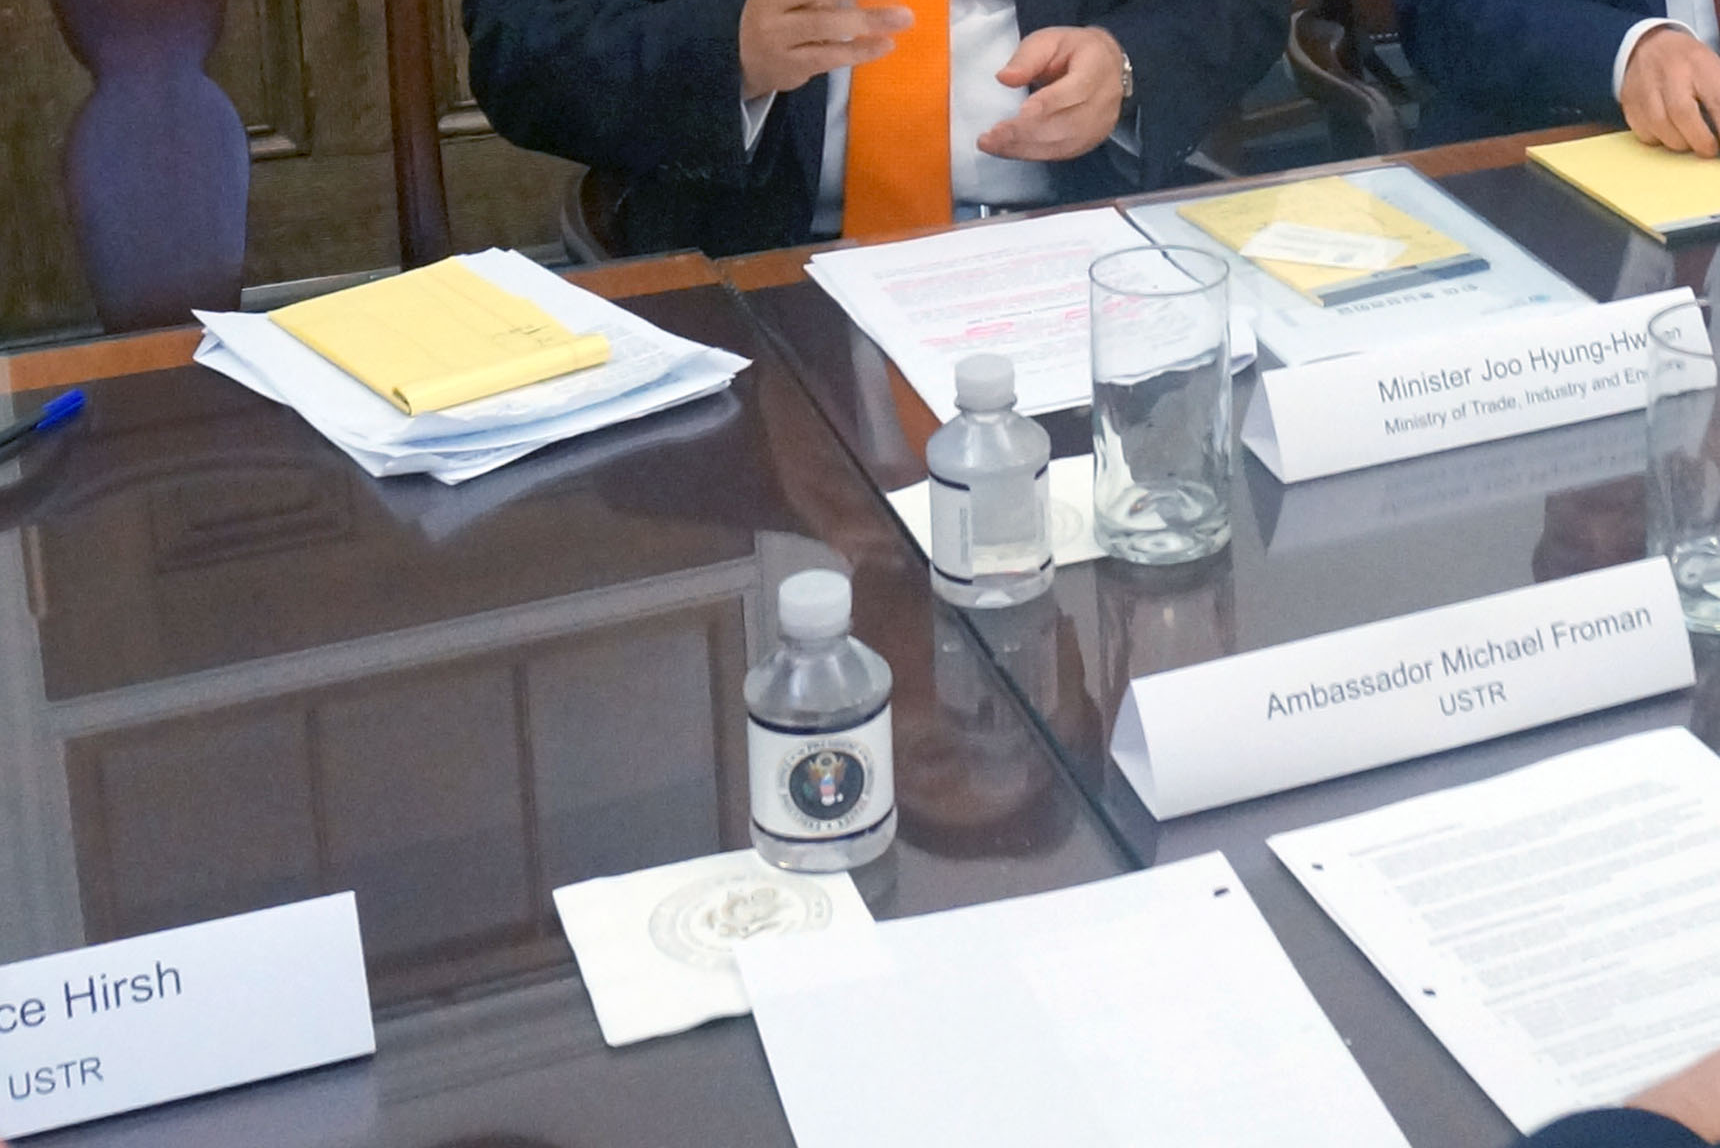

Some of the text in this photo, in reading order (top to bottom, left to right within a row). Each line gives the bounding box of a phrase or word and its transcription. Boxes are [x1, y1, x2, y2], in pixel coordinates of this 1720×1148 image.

[1377, 367, 1472, 403] Minister
[1481, 358, 1523, 382] Joo
[1384, 412, 1448, 436] Ministry
[1452, 403, 1467, 422] of
[1525, 382, 1587, 405] Industry
[1592, 372, 1620, 392] and
[1267, 606, 1652, 720] Ambassador Michael Froman
[1439, 681, 1508, 716] USTR
[64, 960, 182, 1019] Hirsh
[8, 1056, 104, 1101] USTR
